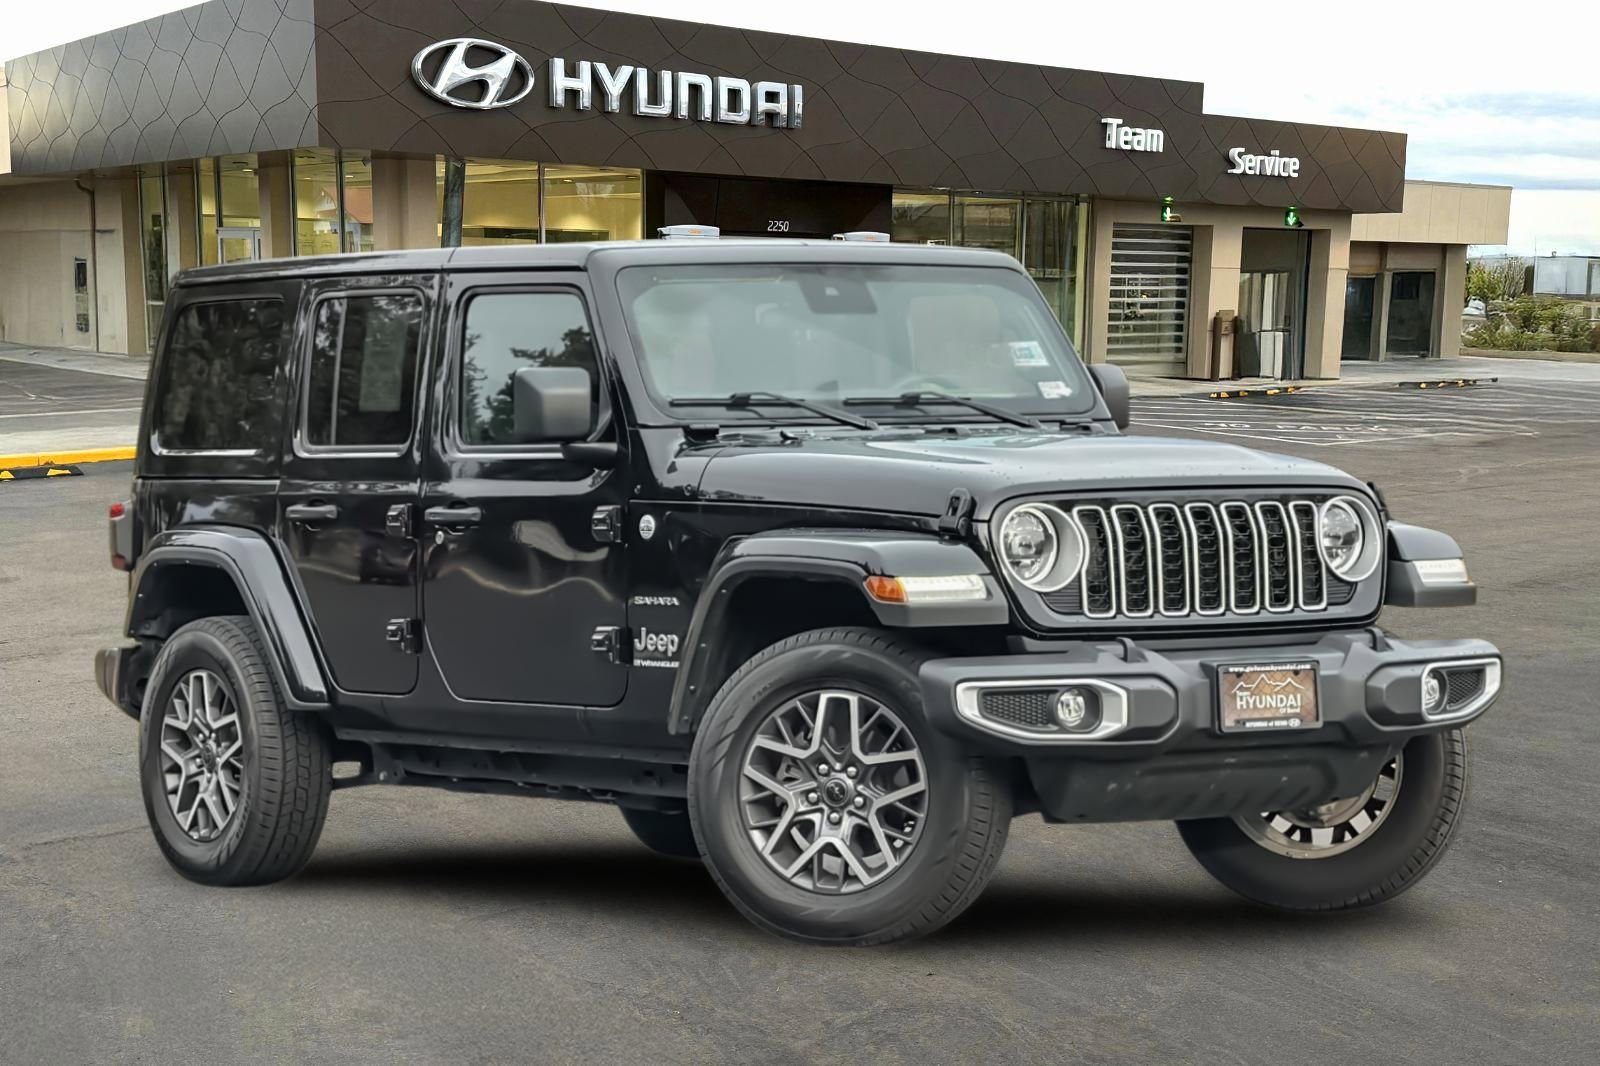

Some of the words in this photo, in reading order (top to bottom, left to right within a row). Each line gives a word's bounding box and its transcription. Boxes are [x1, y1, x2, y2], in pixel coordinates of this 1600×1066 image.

[549, 57, 803, 129] HYUNDAI
[1101, 117, 1164, 153] Team
[1227, 147, 1300, 178] Service
[767, 220, 790, 232] 2250
[634, 595, 680, 606] SAHARA
[633, 627, 679, 657] Jeep
[1236, 693, 1301, 710] HYUNDAI
